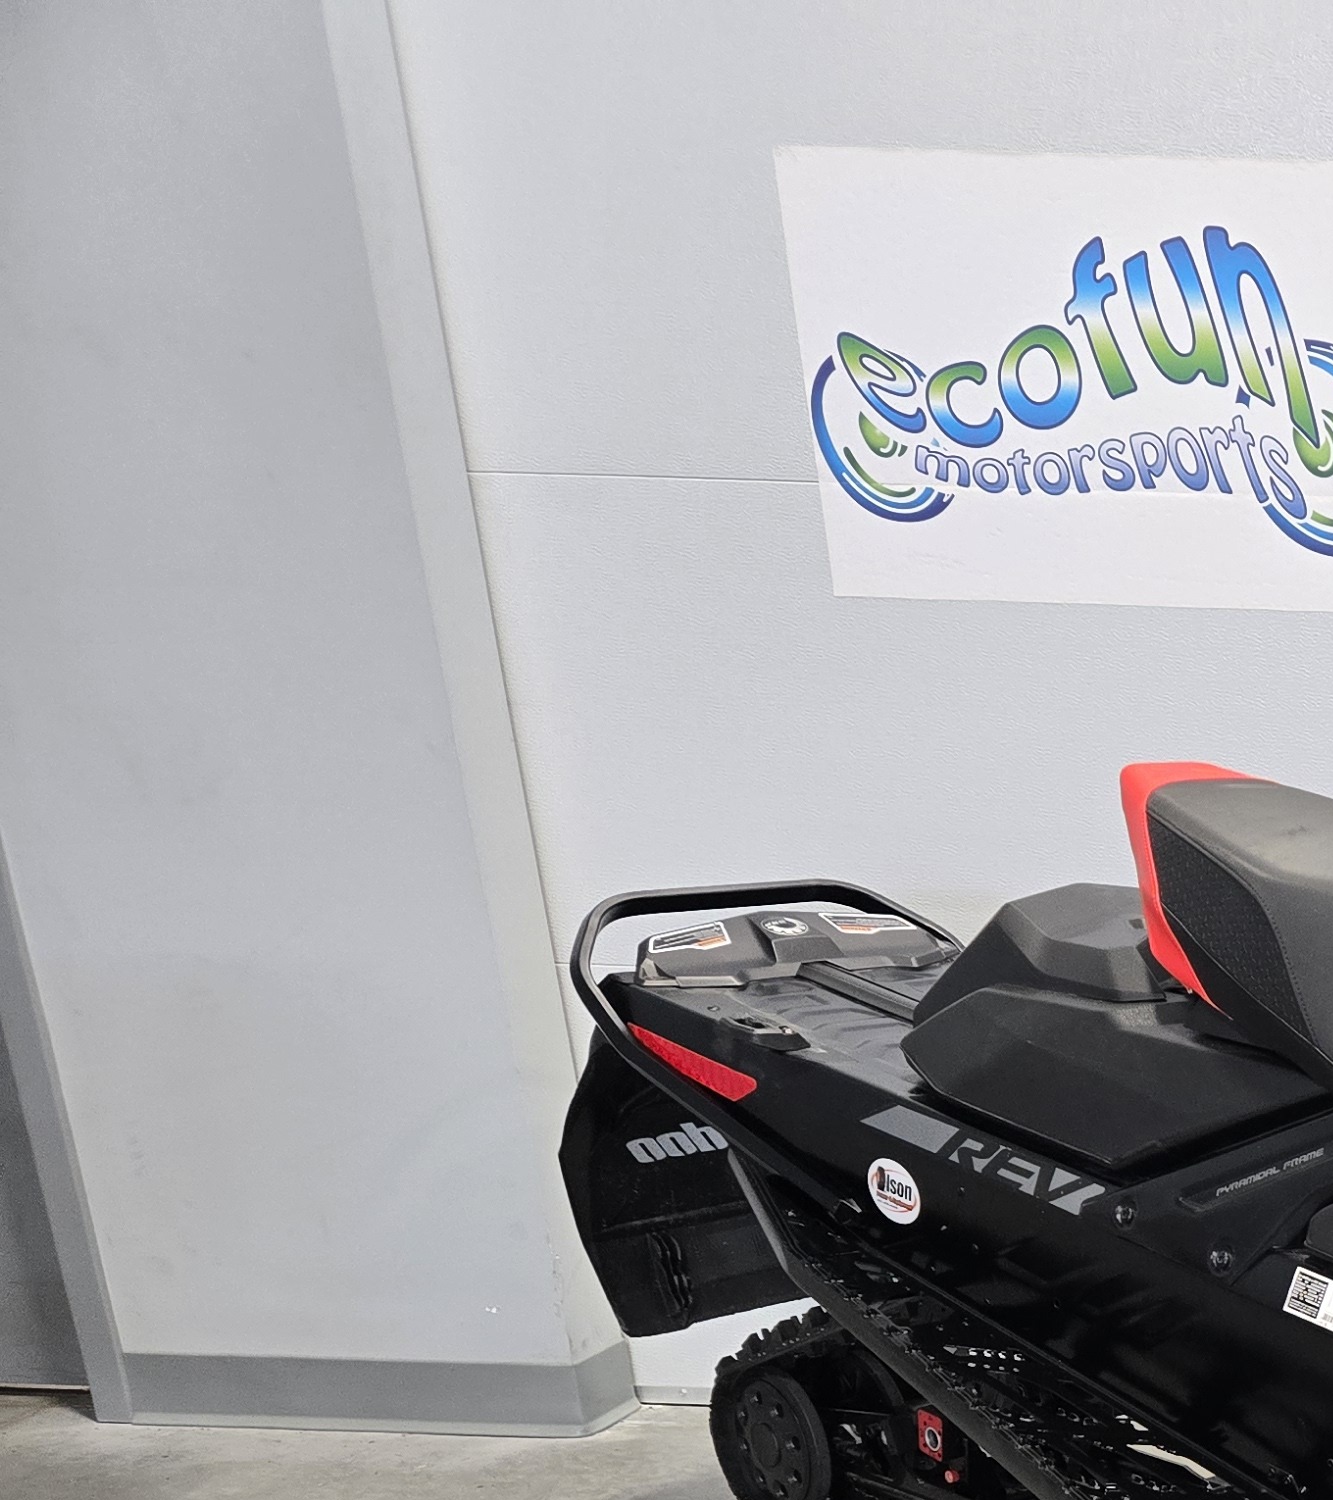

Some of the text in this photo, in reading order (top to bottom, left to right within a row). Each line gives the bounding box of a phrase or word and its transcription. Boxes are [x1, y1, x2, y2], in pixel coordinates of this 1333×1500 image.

[836, 225, 1320, 448] ecofun
[914, 415, 1307, 519] motorsports
[1282, 1147, 1325, 1171] FRAME
